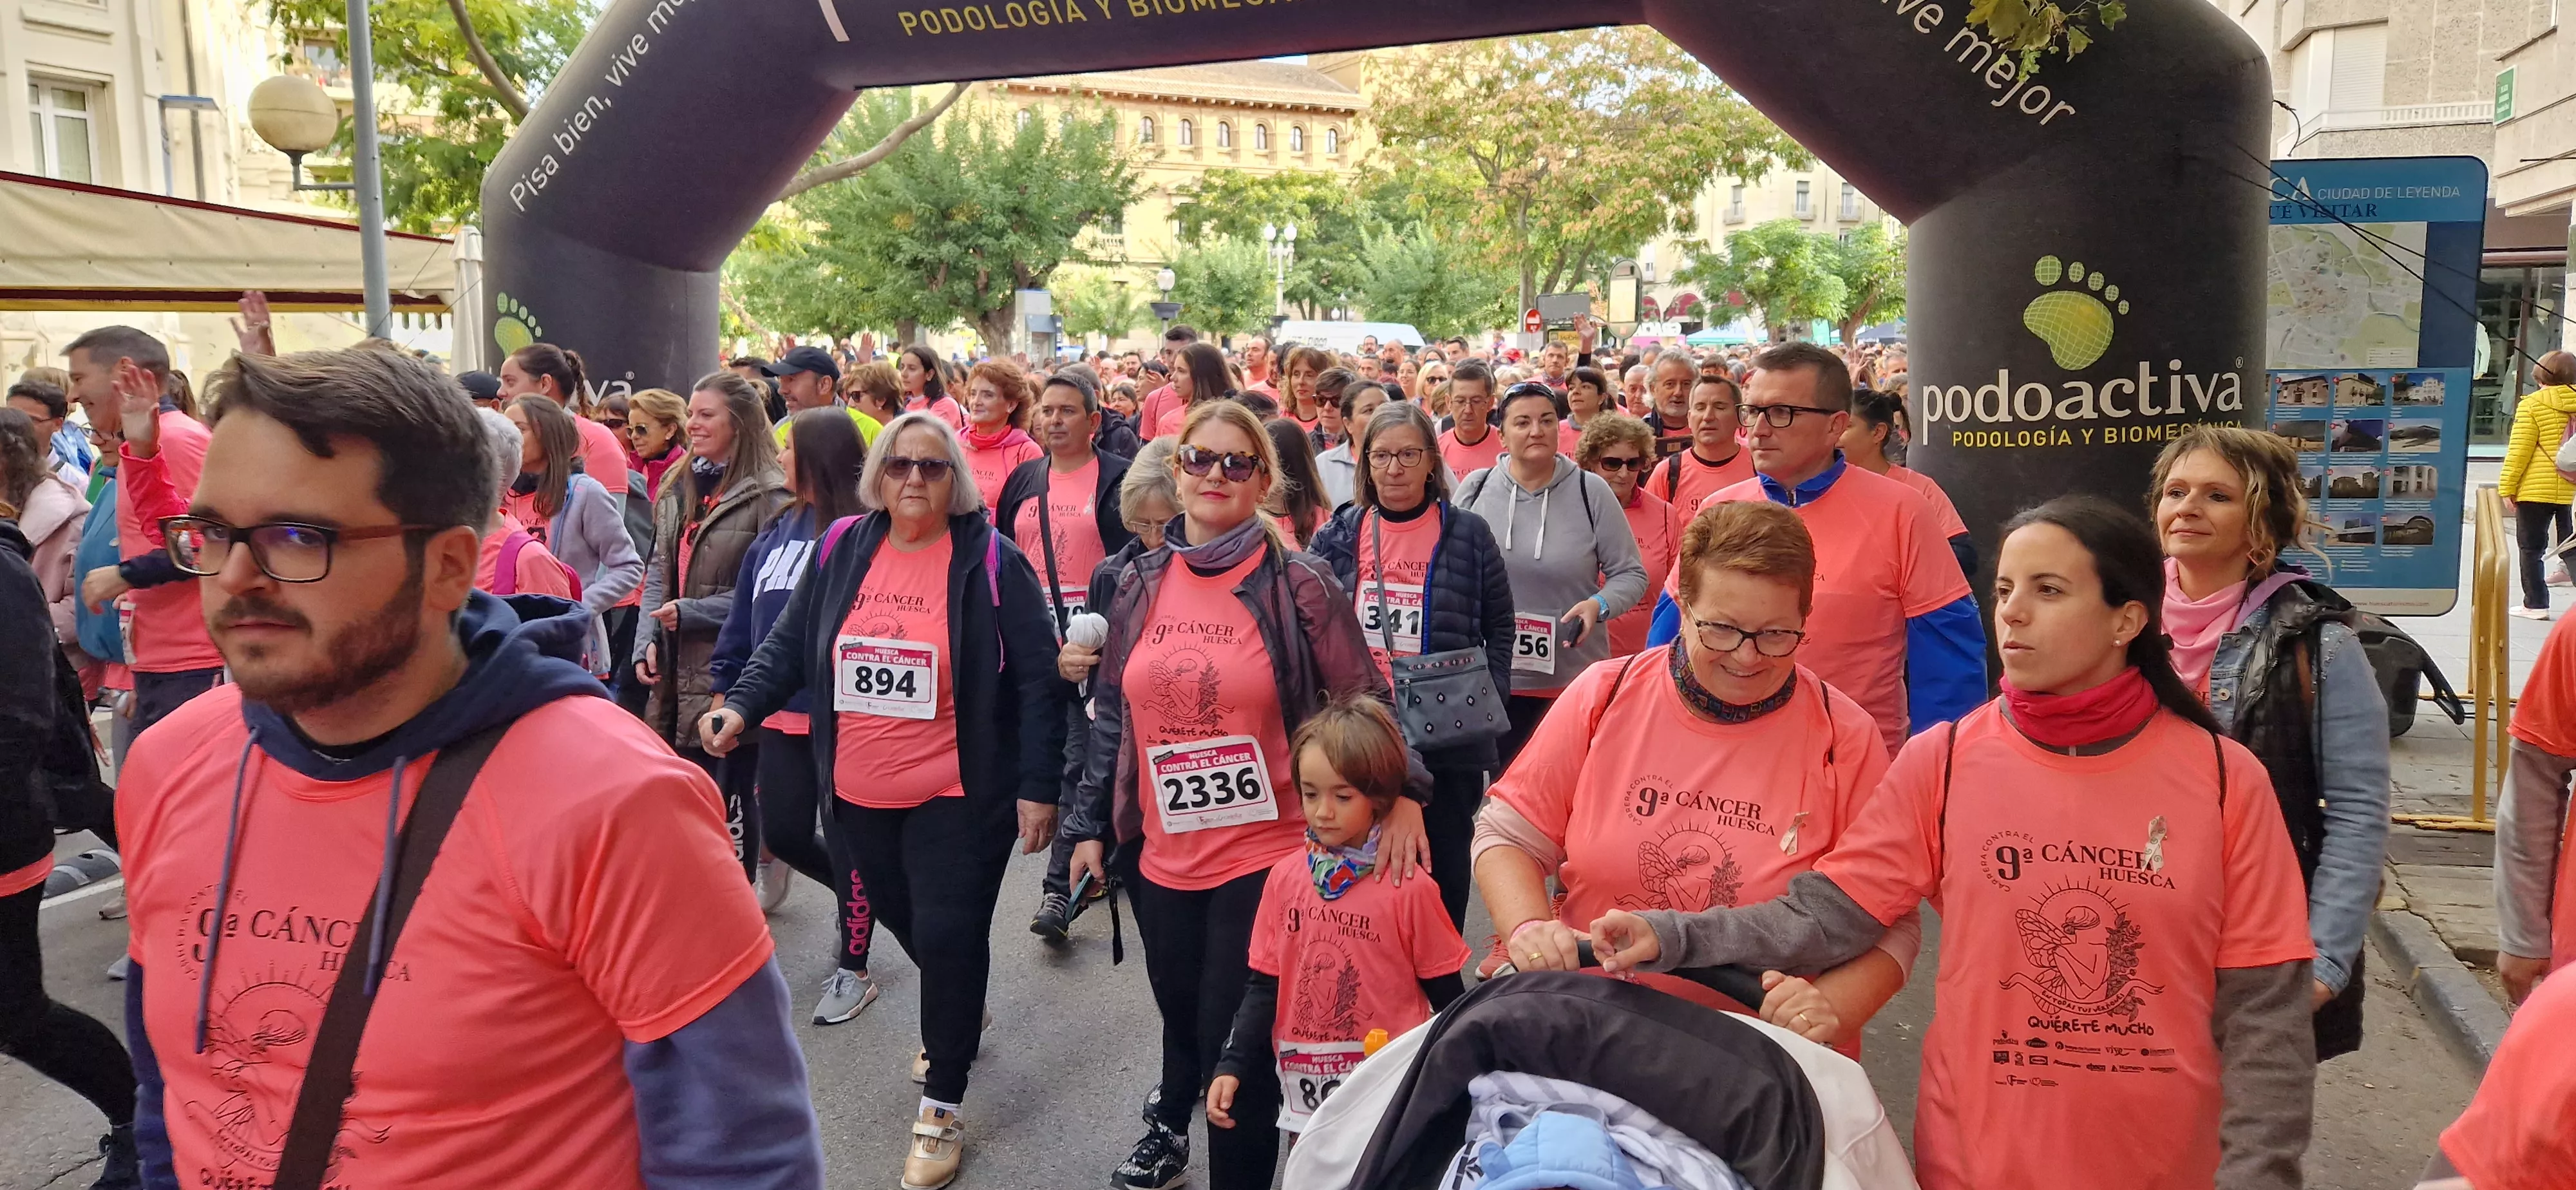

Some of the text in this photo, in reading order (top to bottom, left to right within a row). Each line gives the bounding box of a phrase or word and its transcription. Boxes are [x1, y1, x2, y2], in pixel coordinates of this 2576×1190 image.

[1944, 26, 2076, 125] mejor
[510, 33, 649, 211] Pisa bien, vive
[2318, 187, 2370, 200] CIUDAD
[2374, 187, 2393, 199] DE
[2397, 185, 2460, 198] LEYENDA
[2269, 203, 2378, 219] UÉ VISITAR
[1953, 424, 2072, 448] PODOLOGÍA
[2081, 427, 2095, 445] Y
[875, 592, 924, 607] CÁNCER
[896, 605, 931, 614] HUESCA
[1152, 624, 1173, 645] 9ª
[1177, 620, 1234, 637] CÁNCER
[1524, 624, 1548, 634] CÁNCER
[1203, 636, 1242, 645] HUESCA
[846, 651, 927, 666] CONTRA EL CÁNCER
[875, 647, 899, 656] HUESCA
[855, 666, 917, 699] 894
[1199, 728, 1228, 737] MUCHO
[1160, 751, 1252, 773] CONTRA EL CÁNCER
[1188, 749, 1217, 760] HUESCA
[1163, 767, 1261, 811] 2336
[1630, 774, 1663, 789] CONTRA
[1665, 779, 1674, 789] EL
[1636, 787, 1761, 820] 9ª CÁNCER
[1717, 815, 1776, 836] HUESCA
[1982, 830, 2020, 851] CONTRA
[2023, 833, 2034, 844] EL
[1996, 845, 2034, 880] 9ª
[2099, 867, 2176, 890] HUESCA
[1308, 904, 1370, 930] CÁNCER
[250, 907, 361, 947] CÁNC
[1338, 926, 1381, 943] HUESCA
[2053, 997, 2076, 1010] TODAS
[2027, 1015, 2154, 1036] QUIÉRETE MUCHO
[1284, 1061, 1322, 1074] CONTRA
[1323, 1063, 1336, 1073] EL
[1311, 1054, 1345, 1064] HUESCA
